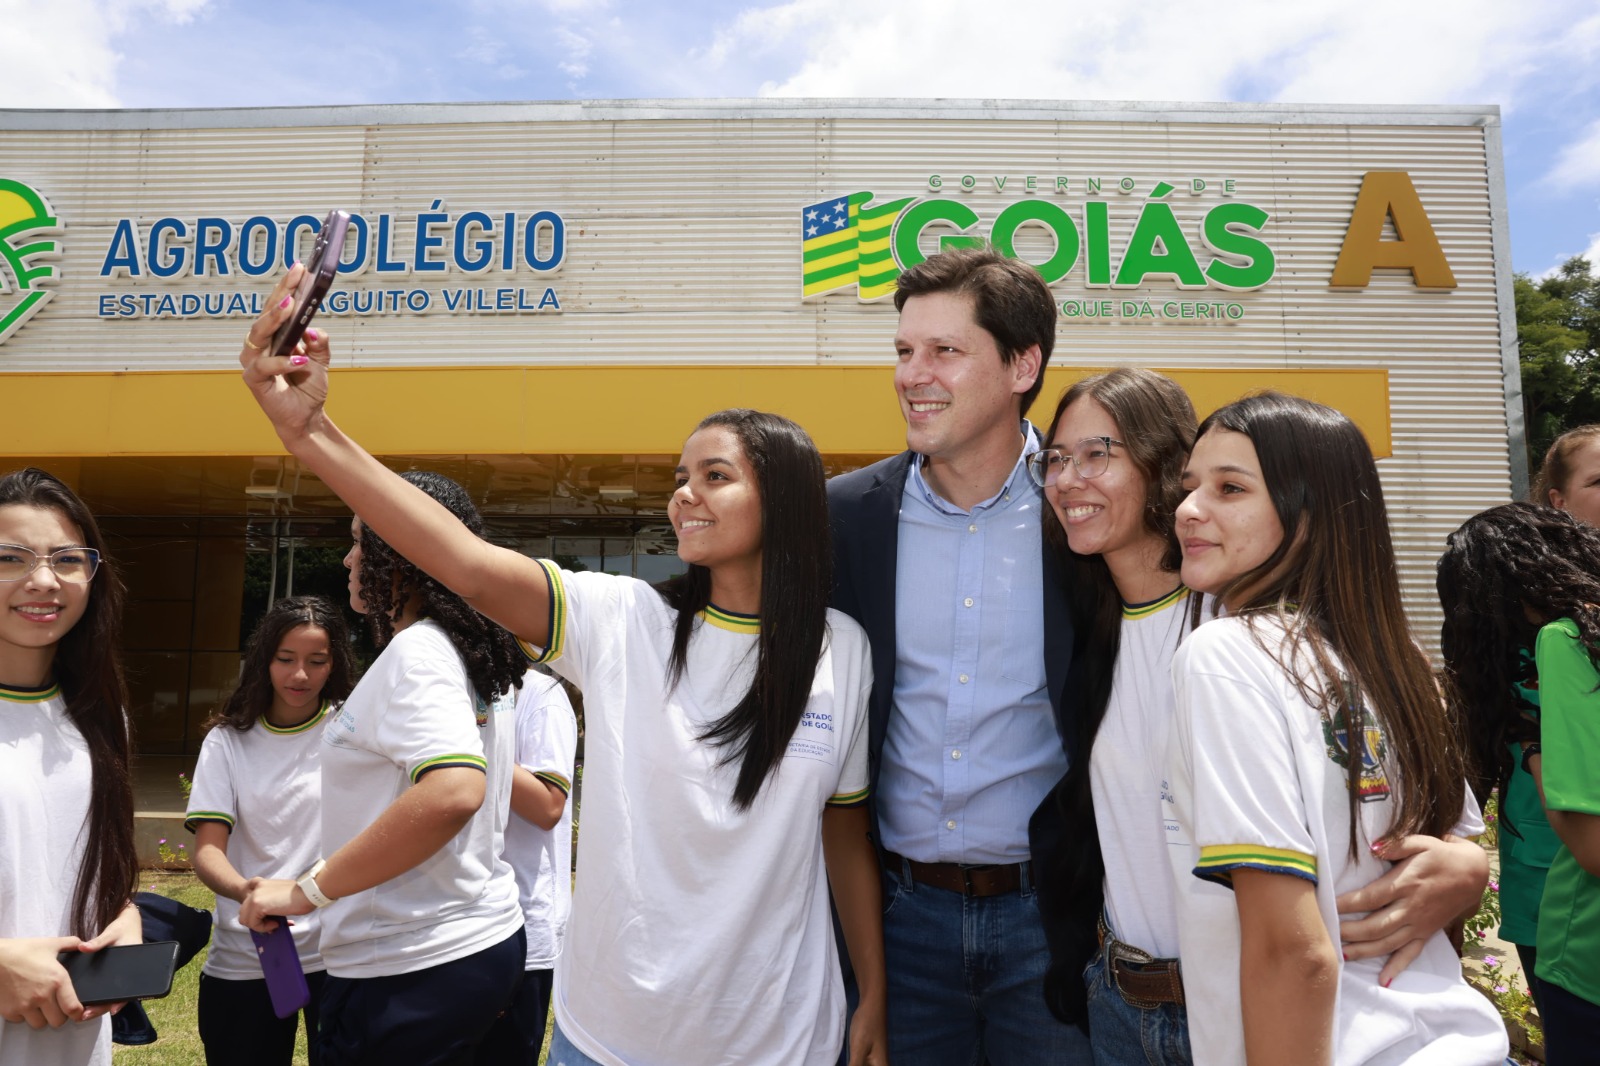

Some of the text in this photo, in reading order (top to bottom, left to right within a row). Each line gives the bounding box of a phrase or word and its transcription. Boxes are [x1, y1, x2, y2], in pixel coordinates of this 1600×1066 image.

[929, 175, 1236, 192] GOVERNO DE
[896, 181, 1275, 288] GOIÁS
[1329, 171, 1458, 289] A
[99, 288, 560, 316] ESTADUAL GUITO VILELA
[1062, 297, 1244, 319] QUE DÁ CERTO
